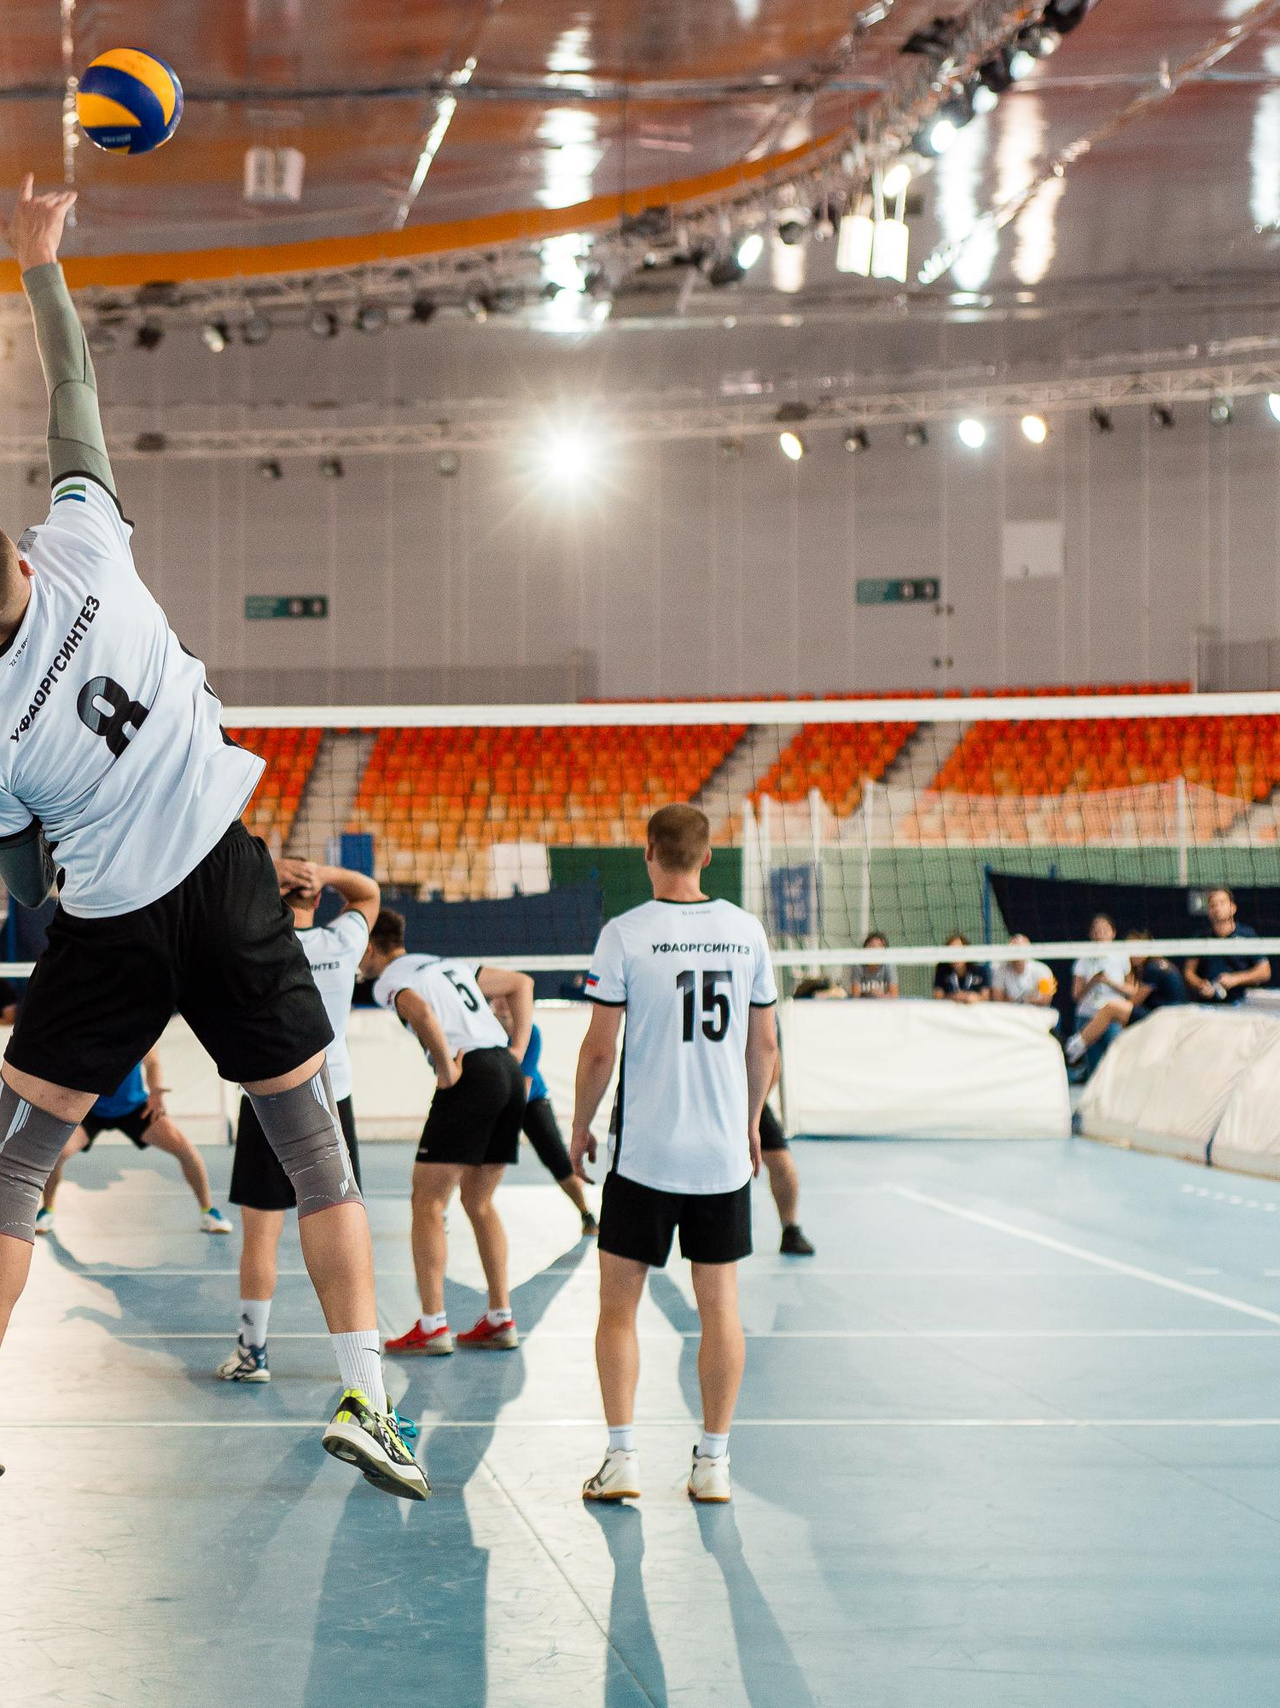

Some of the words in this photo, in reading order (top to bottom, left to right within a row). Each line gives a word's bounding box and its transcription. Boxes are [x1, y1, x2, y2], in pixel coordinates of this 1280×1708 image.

[10, 595, 100, 743] УФАОРГСИНТЕЗ
[77, 675, 150, 759] 8
[651, 942, 751, 956] УФАОРГСИНТЕЗ
[442, 969, 480, 1013] 5
[676, 970, 733, 1043] 15
